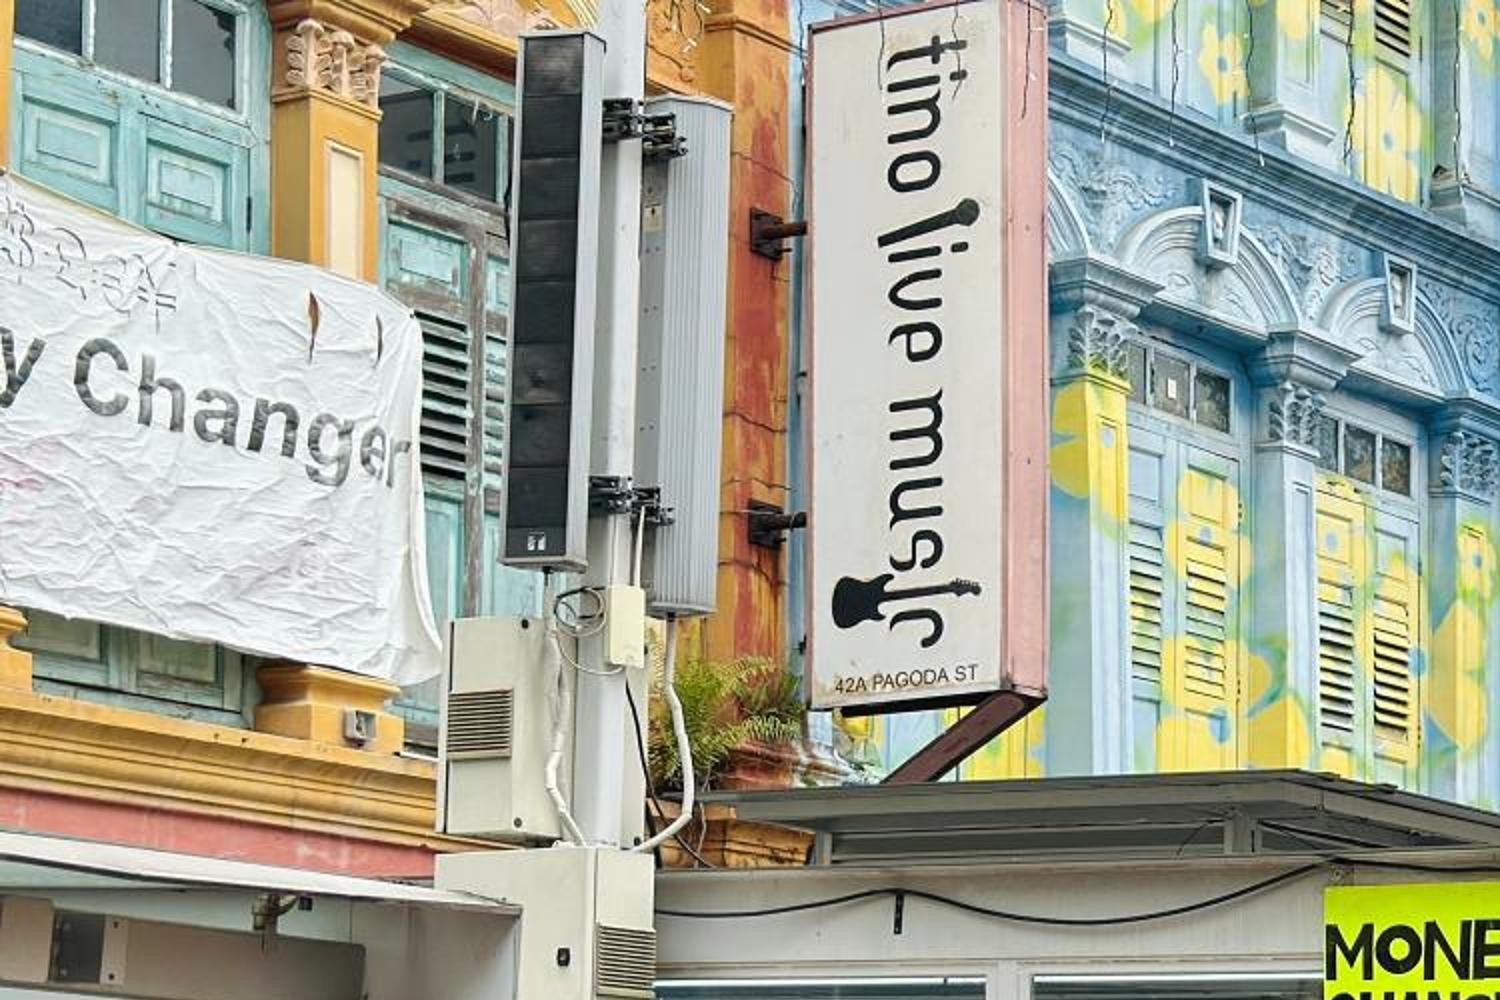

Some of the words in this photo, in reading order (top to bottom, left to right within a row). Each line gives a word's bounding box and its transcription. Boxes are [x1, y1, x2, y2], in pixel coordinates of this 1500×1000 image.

[887, 35, 967, 193] tino
[877, 197, 980, 363] live
[73, 338, 412, 488] Changer
[835, 676, 867, 694] 42A
[874, 667, 949, 689] PAGODA
[955, 664, 979, 682] ST
